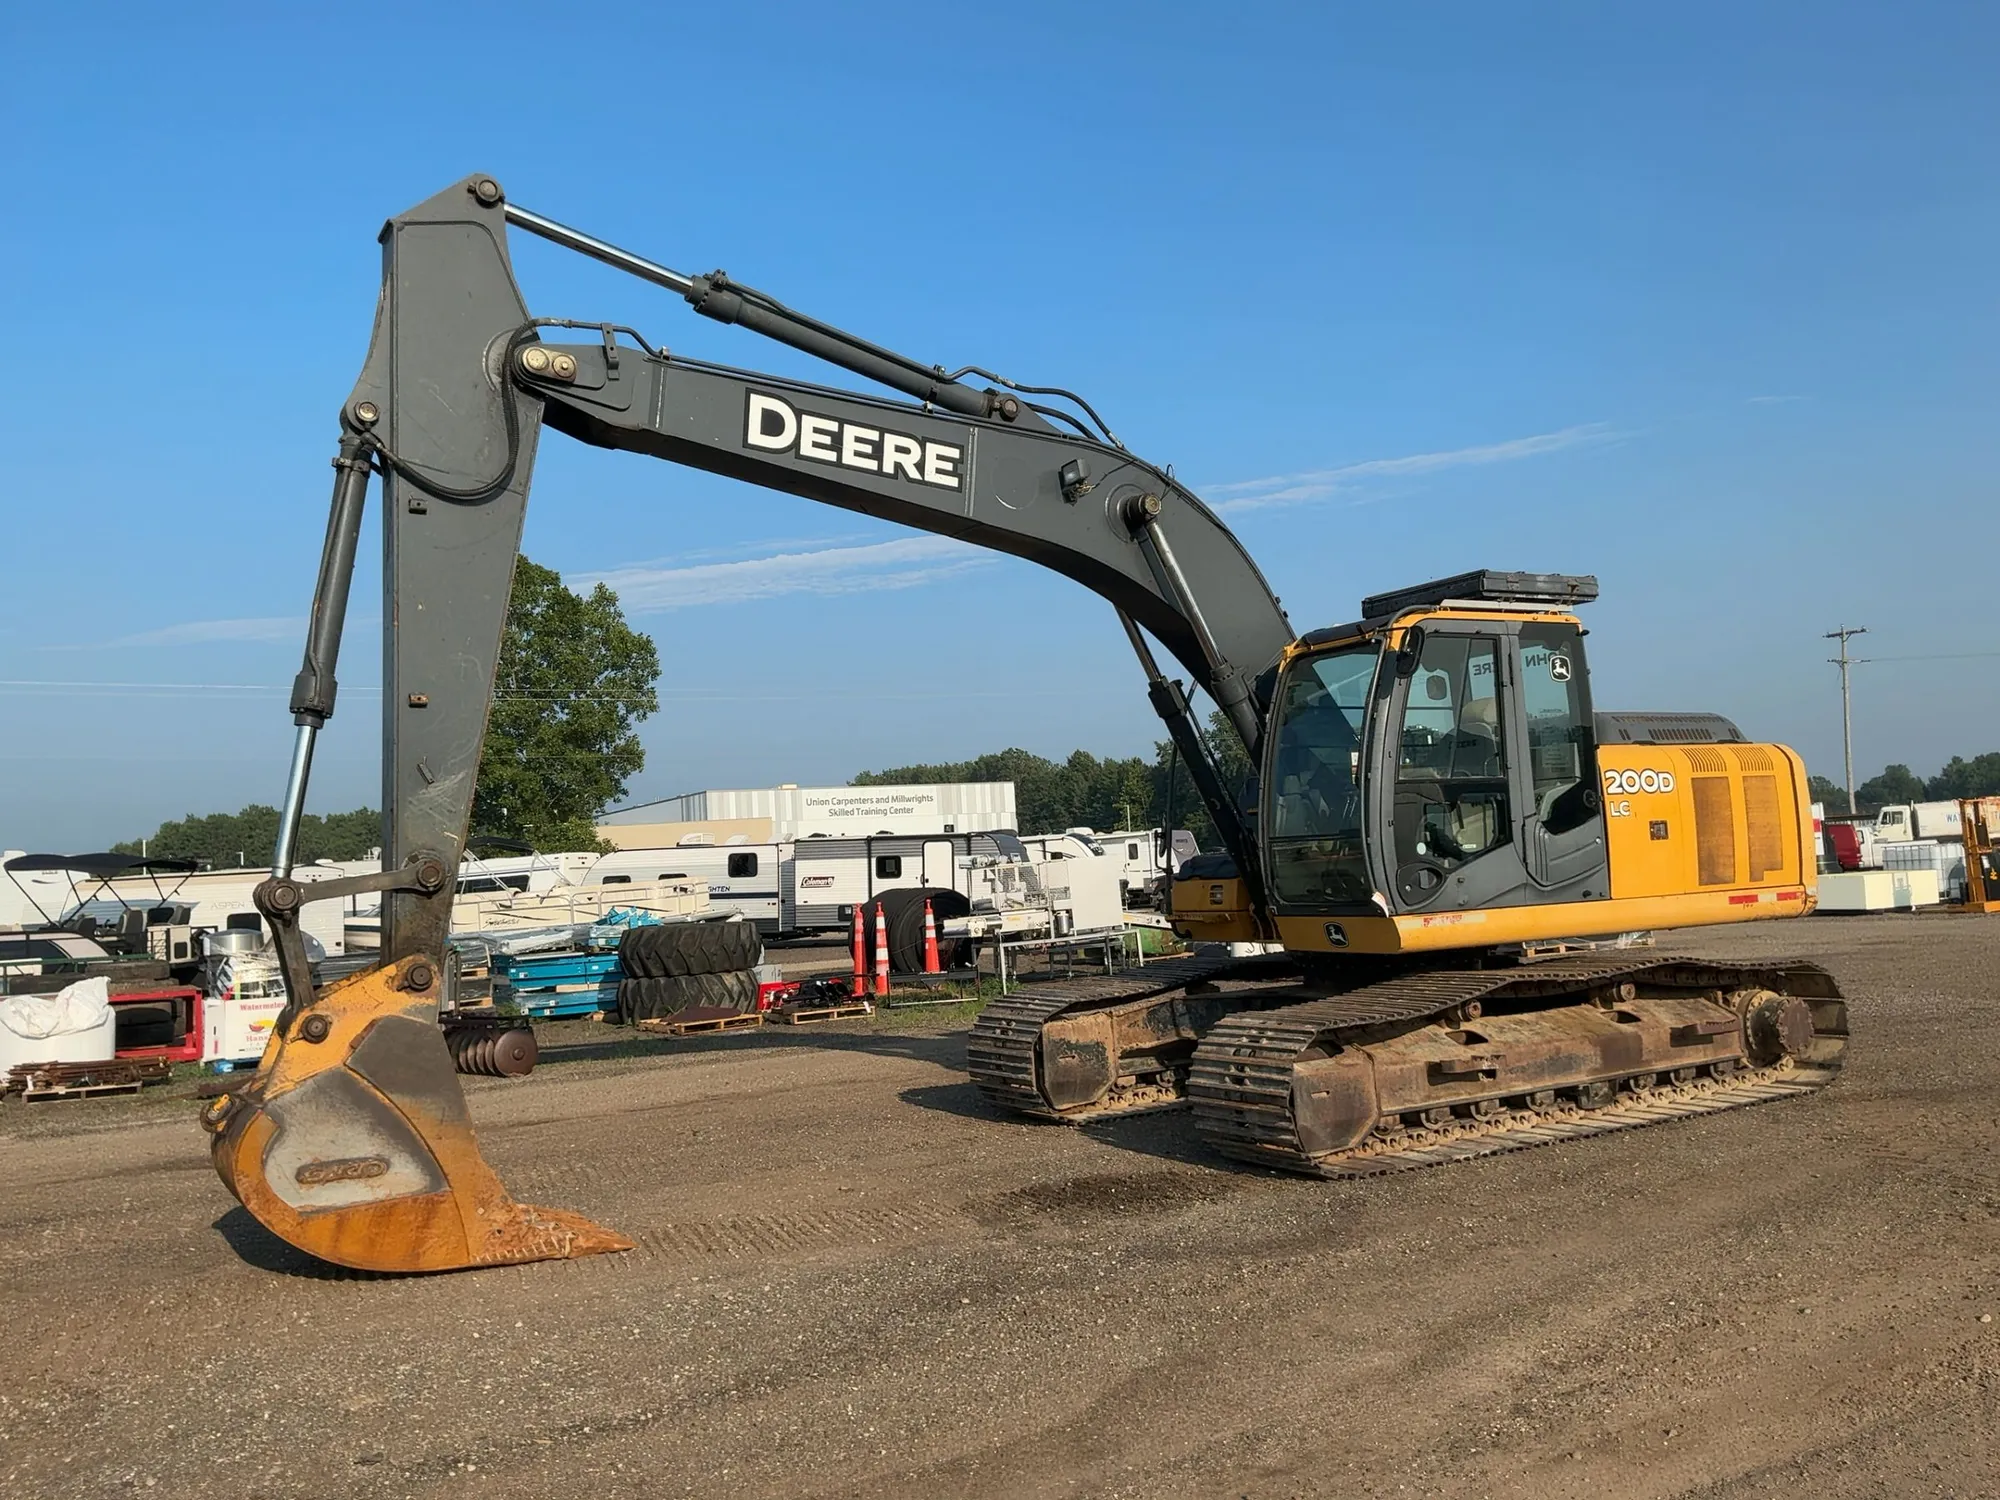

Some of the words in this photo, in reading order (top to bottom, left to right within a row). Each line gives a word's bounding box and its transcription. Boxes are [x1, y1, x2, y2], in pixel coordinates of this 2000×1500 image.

[747, 392, 961, 488] DEERE
[1604, 768, 1675, 794] 200D
[806, 798, 830, 807] Union
[831, 796, 874, 806] Carpenters
[875, 795, 890, 804] and
[891, 794, 934, 805] Millwrights
[828, 808, 855, 817] Skilled
[856, 806, 888, 817] Training
[889, 806, 914, 815] Center
[1609, 801, 1631, 817] LC
[801, 877, 828, 888] Coleman
